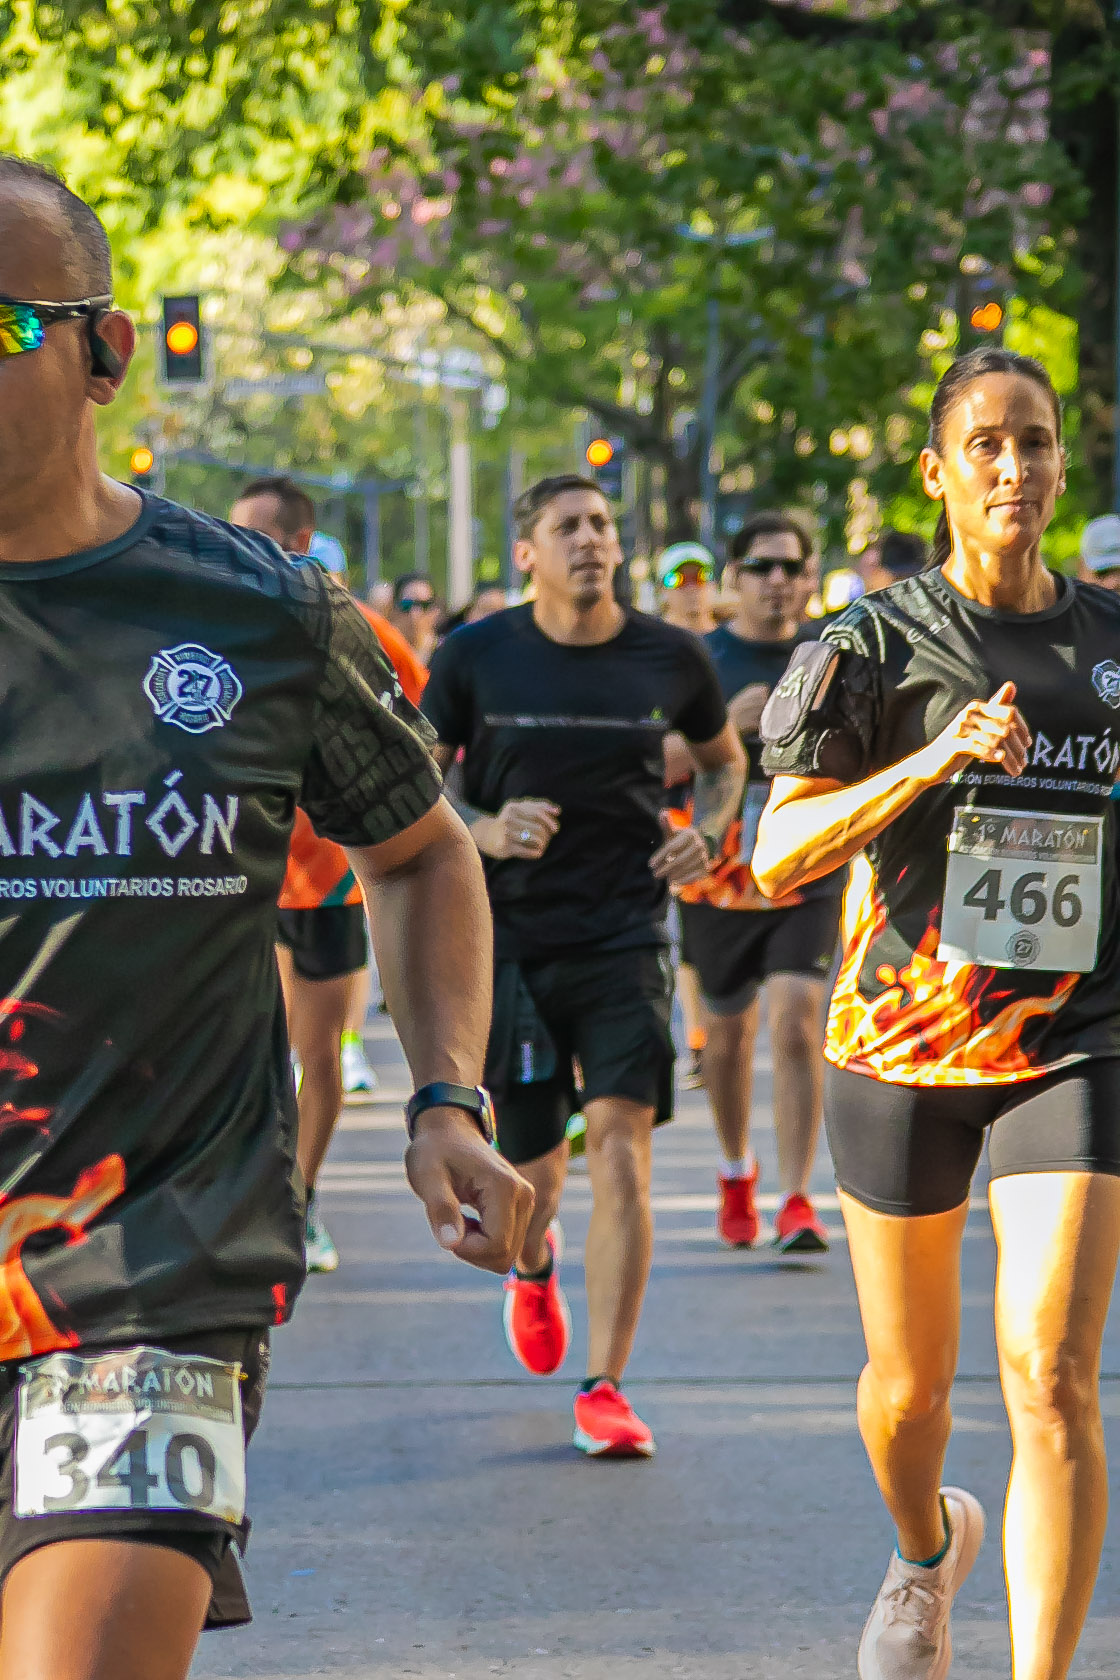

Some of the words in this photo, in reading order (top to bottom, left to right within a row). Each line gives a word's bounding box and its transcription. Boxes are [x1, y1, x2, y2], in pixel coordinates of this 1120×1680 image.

[177, 668, 214, 698] 27
[977, 823, 997, 842] 1º
[999, 823, 1087, 849] MARATÓN
[40, 876, 175, 899] VOLUNTARIOS
[177, 873, 248, 898] ROSARIO
[962, 869, 1083, 928] 466
[42, 1429, 216, 1509] 340
